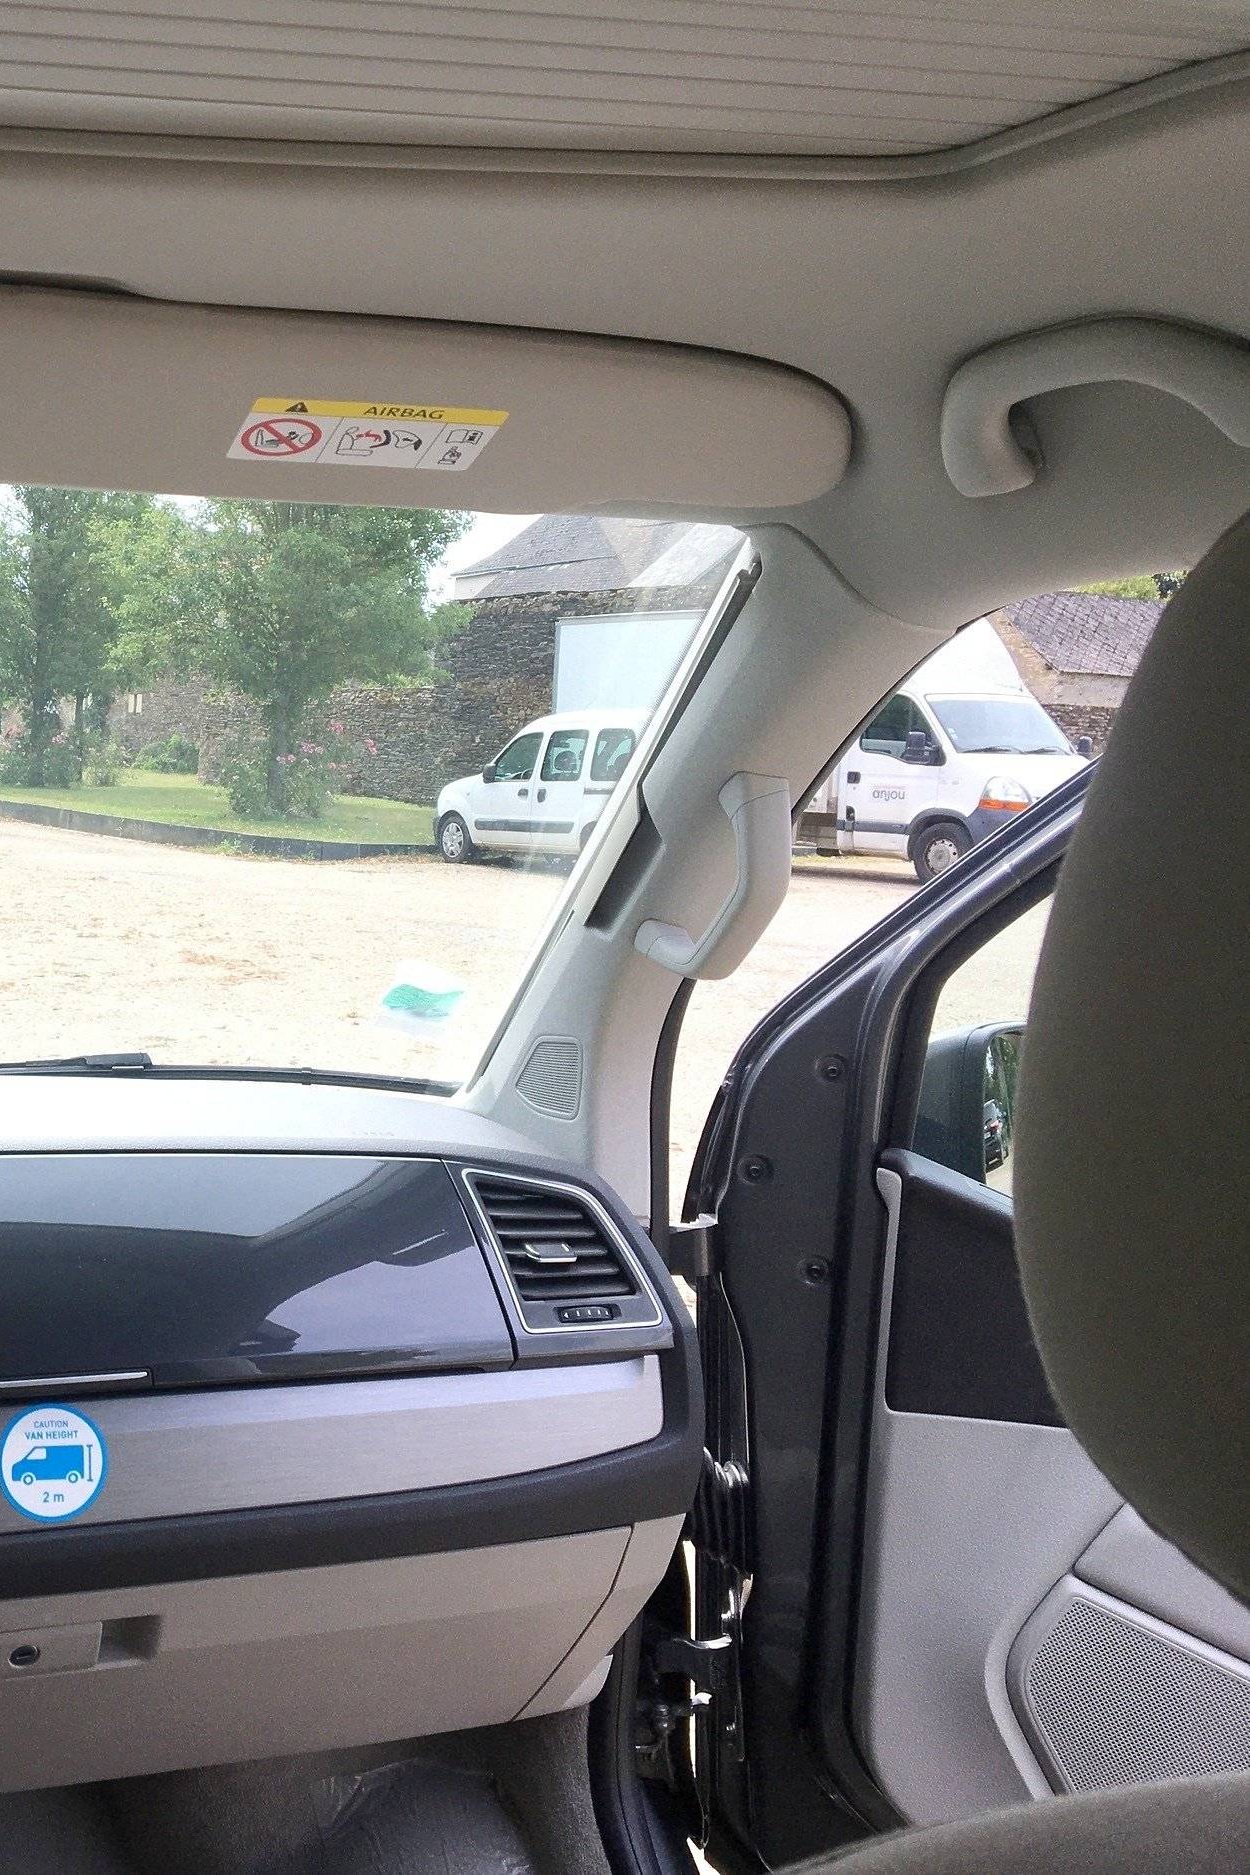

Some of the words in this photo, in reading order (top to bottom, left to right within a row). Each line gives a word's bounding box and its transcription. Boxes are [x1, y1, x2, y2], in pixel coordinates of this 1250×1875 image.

[363, 406, 445, 420] AIRBAG
[872, 789, 906, 802] anjou
[33, 1420, 69, 1429] CAUTION
[24, 1432, 44, 1441] VAN
[46, 1430, 79, 1440] HEIGHT
[43, 1492, 51, 1503] 2
[53, 1494, 65, 1503] m
